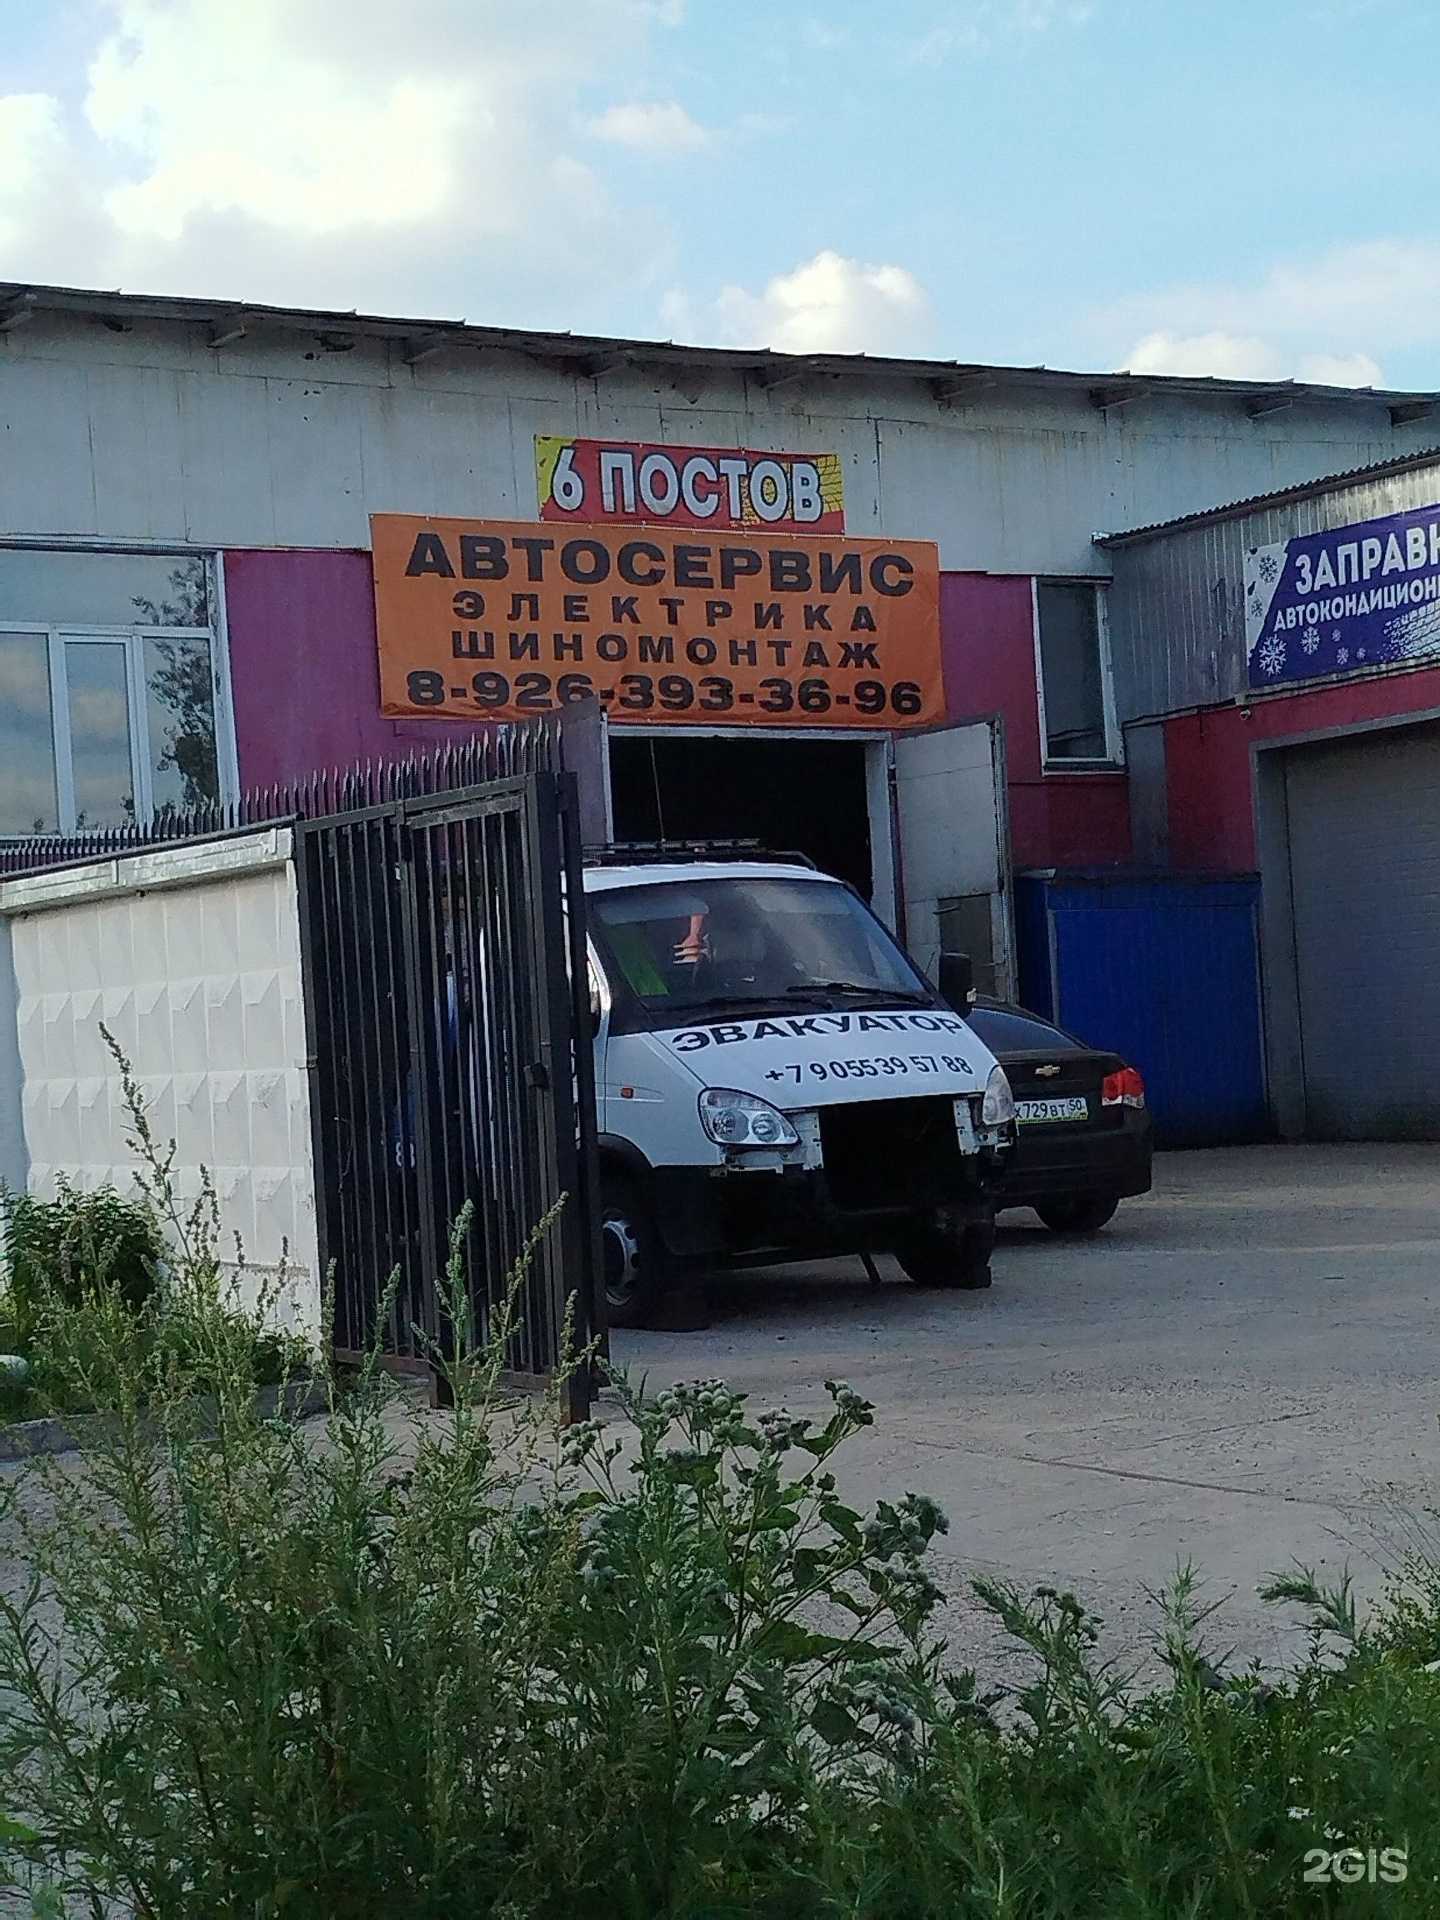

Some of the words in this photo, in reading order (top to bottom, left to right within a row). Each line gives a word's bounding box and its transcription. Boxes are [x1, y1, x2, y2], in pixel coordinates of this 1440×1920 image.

[552, 447, 584, 512] 6
[600, 451, 824, 523] ПОСТОВ
[405, 532, 914, 597] АВТОСЕРВИС
[452, 591, 877, 632] ЭЛЕКТРИКА
[1273, 574, 1440, 632] АВТОКОНДИЦИОН
[452, 631, 881, 670] ШИНОМОНТАЖ
[406, 670, 922, 716] 8-926-393-36-96
[671, 1014, 963, 1052] ЭВАКУАТОР
